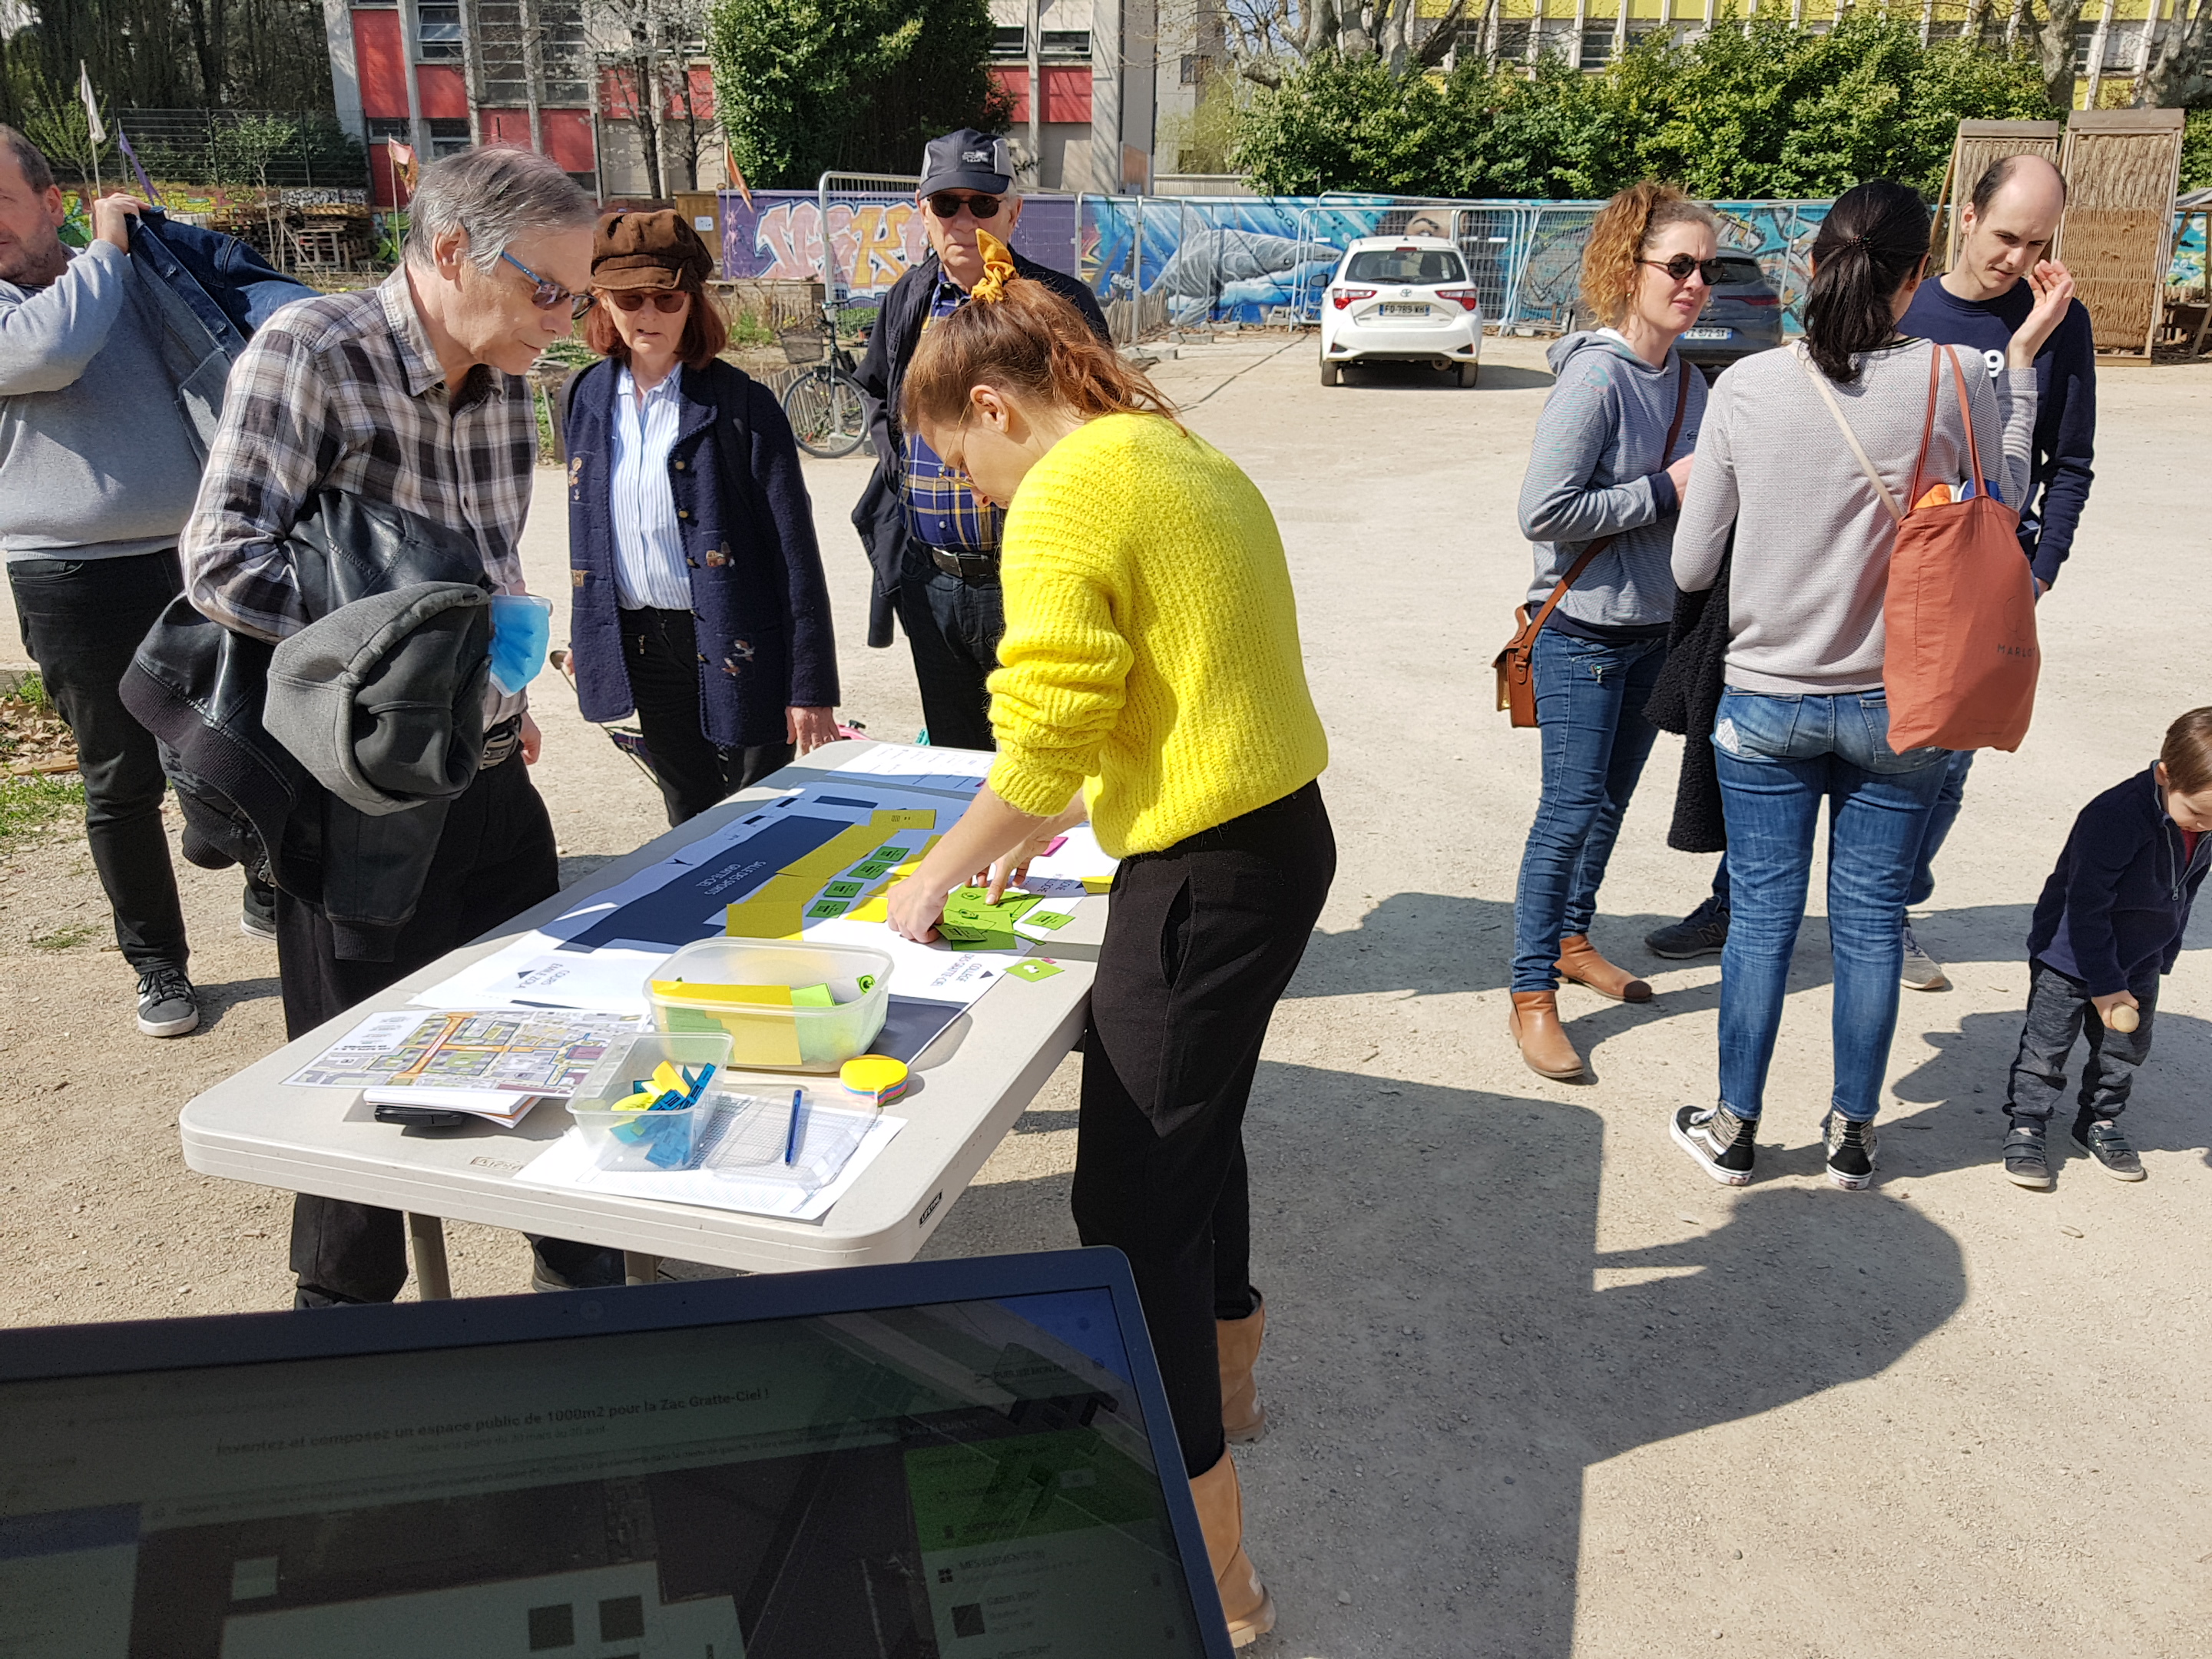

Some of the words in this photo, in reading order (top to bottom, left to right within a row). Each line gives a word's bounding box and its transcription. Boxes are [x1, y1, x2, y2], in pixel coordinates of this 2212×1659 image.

[740, 860, 767, 875] SALLE
[728, 871, 748, 883] DES
[704, 879, 737, 896] SPORTS
[216, 1439, 285, 1457] Inventez
[289, 1435, 306, 1449] et
[309, 1429, 390, 1447] composez
[394, 1426, 414, 1439] un
[417, 1419, 472, 1439] espace
[475, 1414, 521, 1433] public
[523, 1411, 542, 1425] de
[546, 1405, 604, 1423] 1000m2
[608, 1402, 641, 1419] pour
[644, 1399, 657, 1412] la
[660, 1397, 686, 1411] Zac
[688, 1388, 761, 1409] Gratte-Ciel
